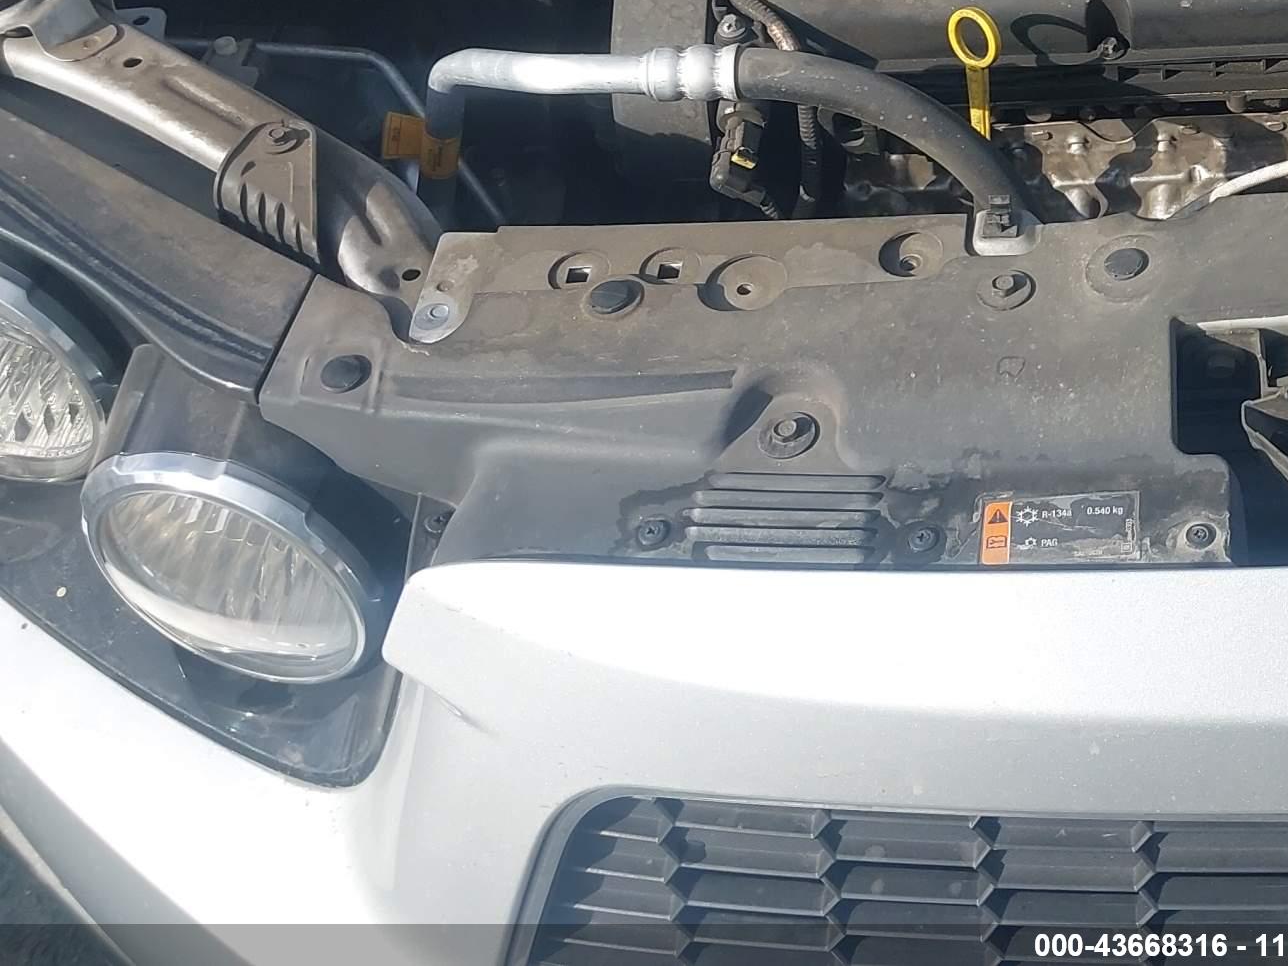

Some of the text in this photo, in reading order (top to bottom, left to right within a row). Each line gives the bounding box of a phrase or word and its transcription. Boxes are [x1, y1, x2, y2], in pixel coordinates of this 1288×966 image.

[1042, 506, 1123, 518] R-134a 0.540 kg
[1041, 539, 1057, 547] PAG
